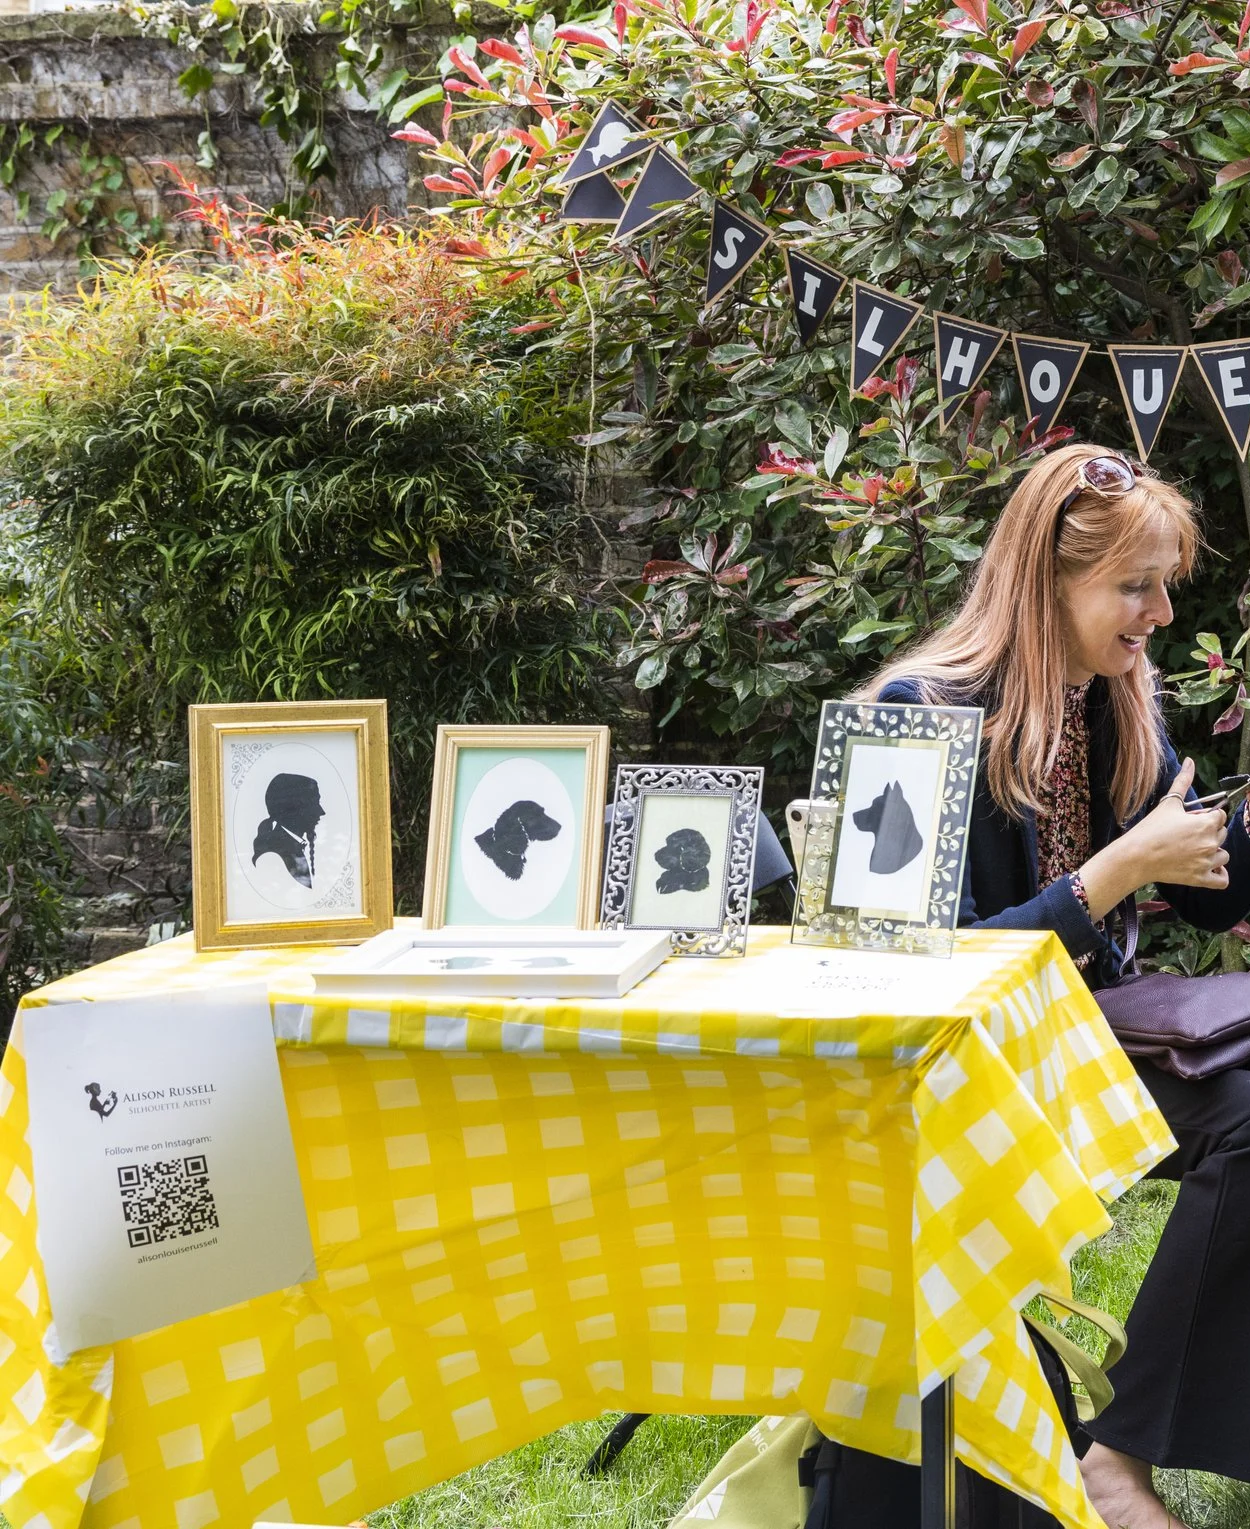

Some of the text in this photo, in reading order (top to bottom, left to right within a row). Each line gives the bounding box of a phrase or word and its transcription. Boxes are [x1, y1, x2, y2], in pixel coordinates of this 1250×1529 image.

[123, 1084, 216, 1103] ALISON RUSSELL
[104, 1136, 212, 1157] Follow me on Instagram:
[137, 1238, 218, 1263] alisonlouiserussell
